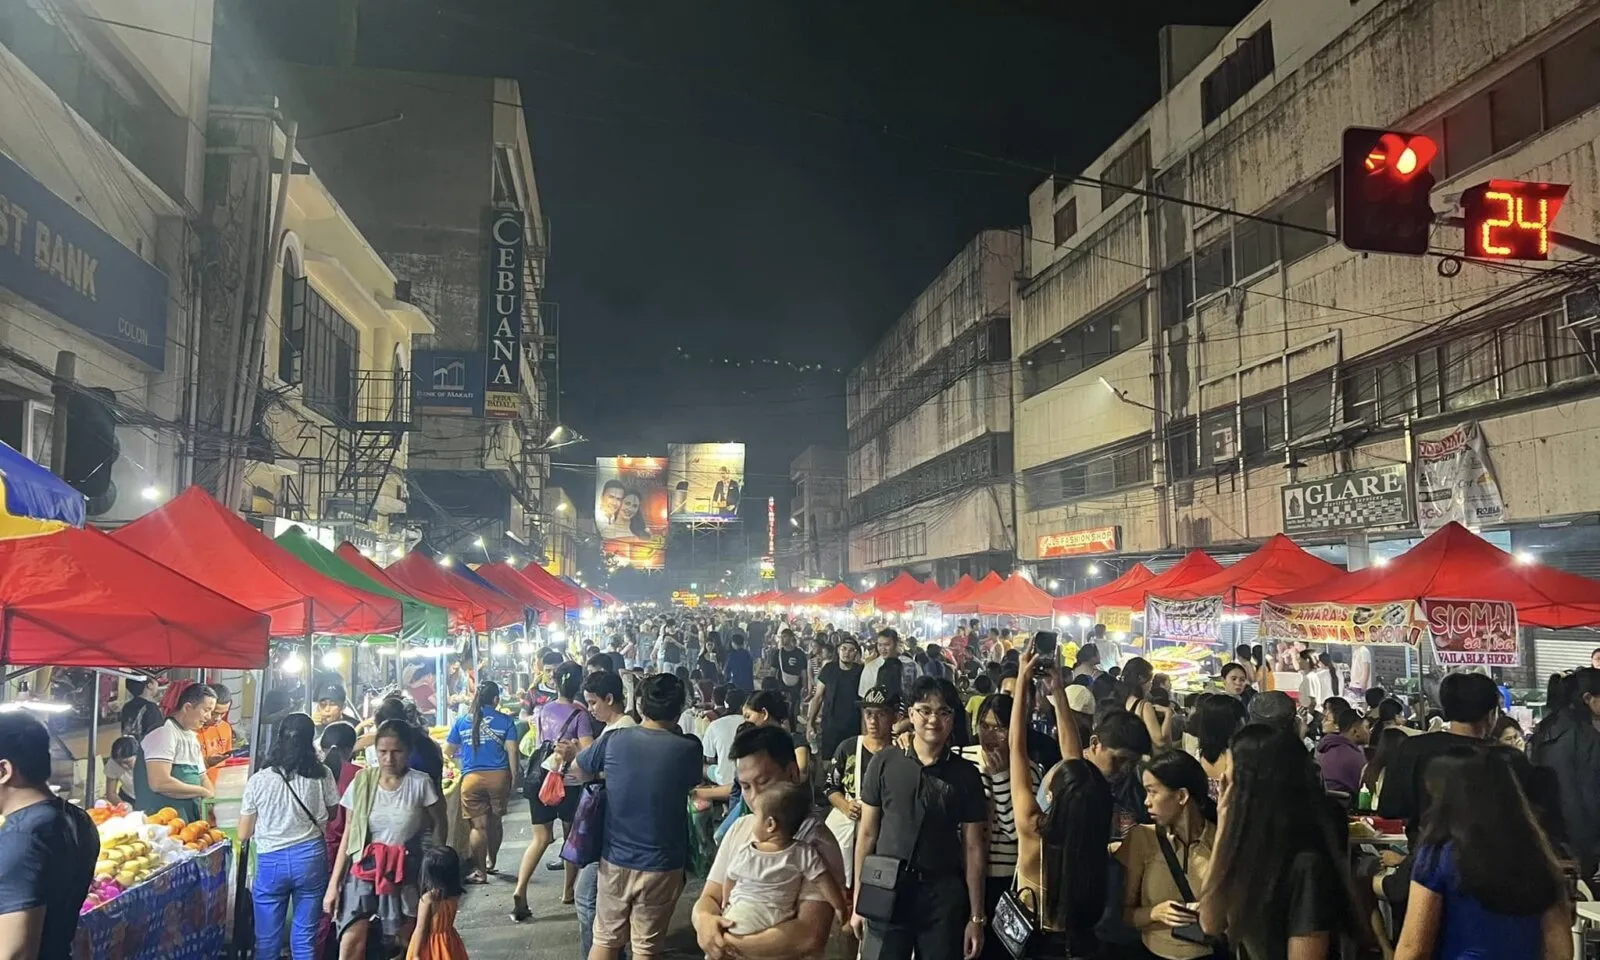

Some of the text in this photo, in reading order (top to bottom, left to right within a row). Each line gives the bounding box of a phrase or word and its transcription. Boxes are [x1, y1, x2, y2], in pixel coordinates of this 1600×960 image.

[1482, 191, 1547, 255] 24
[34, 221, 99, 302] BANK
[492, 214, 521, 385] CEBUANA
[118, 316, 148, 347] COLON
[488, 401, 516, 409] PADALA
[1305, 472, 1402, 505] GLARE
[1295, 606, 1348, 621] AMARA'S
[1430, 602, 1512, 639] SIOMAI
[1353, 625, 1365, 642] &
[1463, 636, 1481, 650] sa
[1438, 652, 1485, 664] VAILABLE
